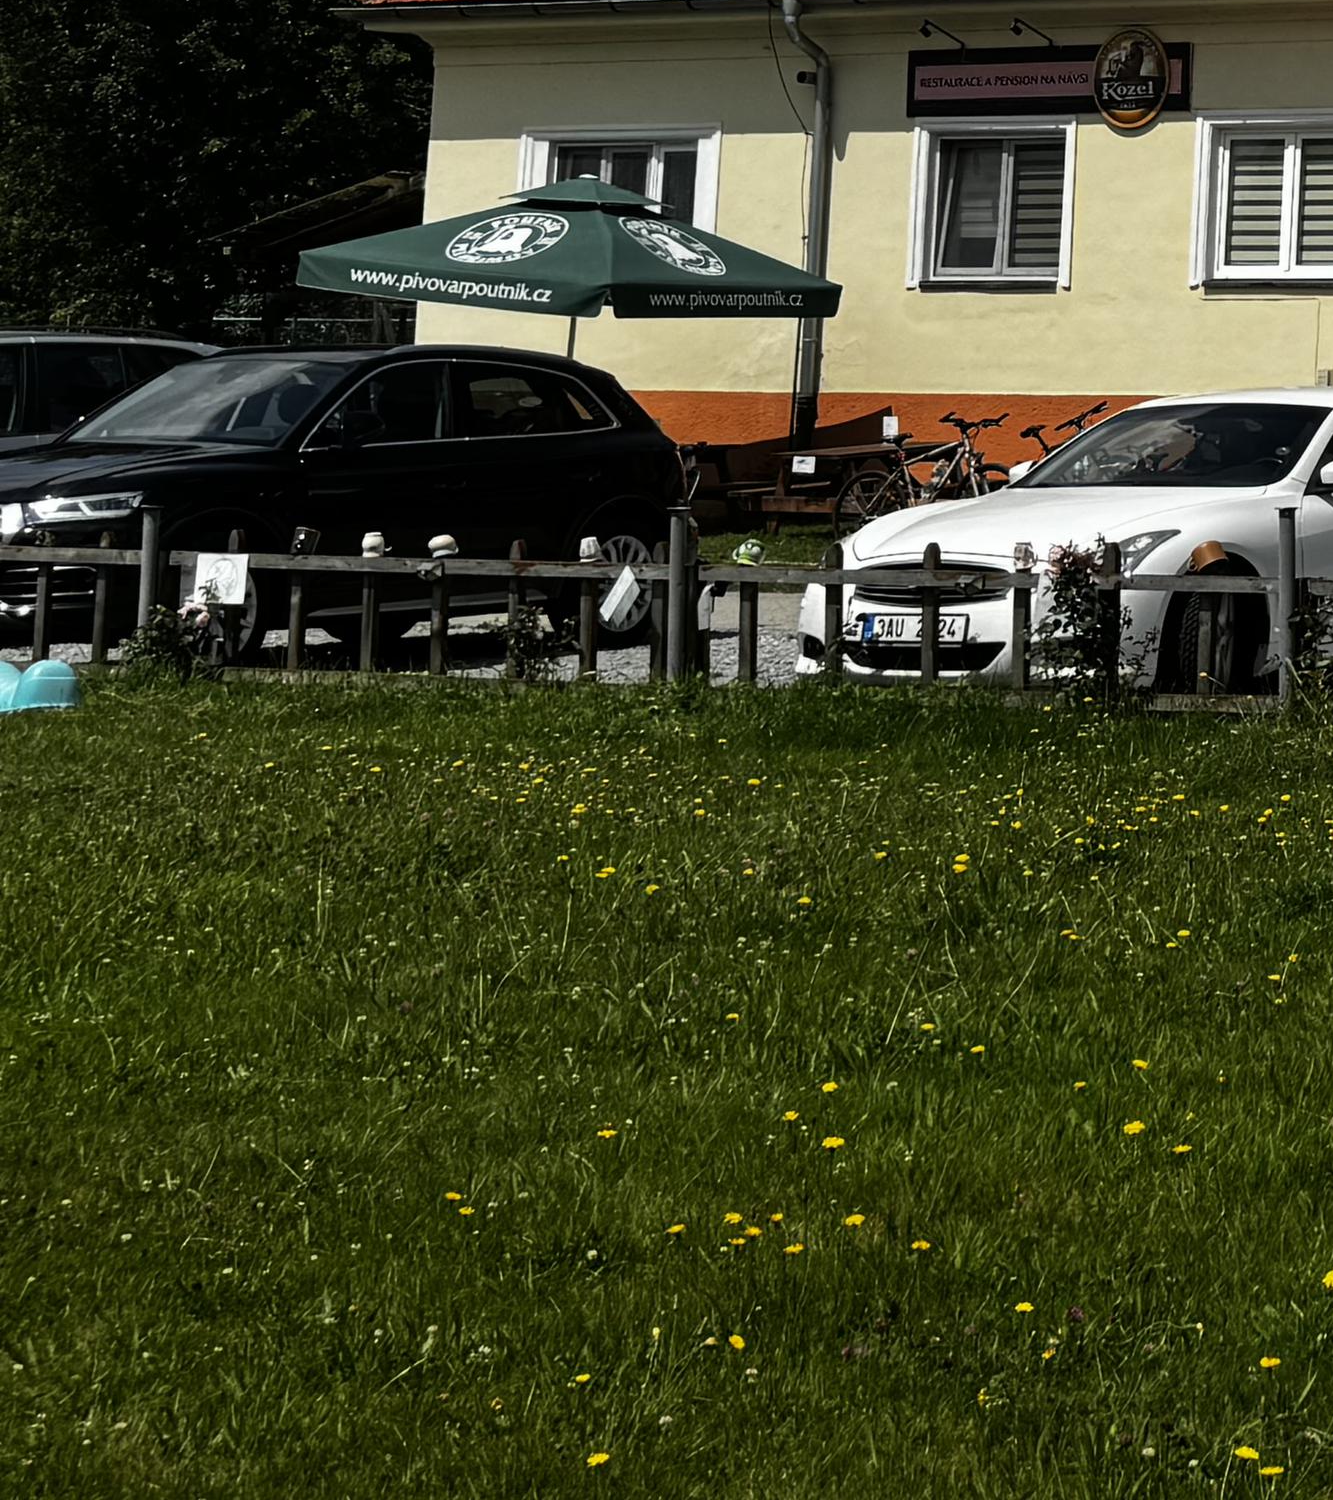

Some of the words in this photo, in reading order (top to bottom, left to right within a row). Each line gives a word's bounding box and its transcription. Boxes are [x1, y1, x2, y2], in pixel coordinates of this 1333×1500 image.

[920, 76, 983, 88] RESTAURACE
[984, 77, 992, 86] A
[994, 75, 1038, 86] PENSION
[1040, 74, 1055, 85] NA
[1101, 80, 1156, 101] Kozel
[350, 266, 552, 303] www.pivovarpoutnik.cz
[649, 289, 804, 309] www.pivovarpoutnik.cz
[877, 619, 905, 638] 3AU
[916, 619, 957, 638] 224
